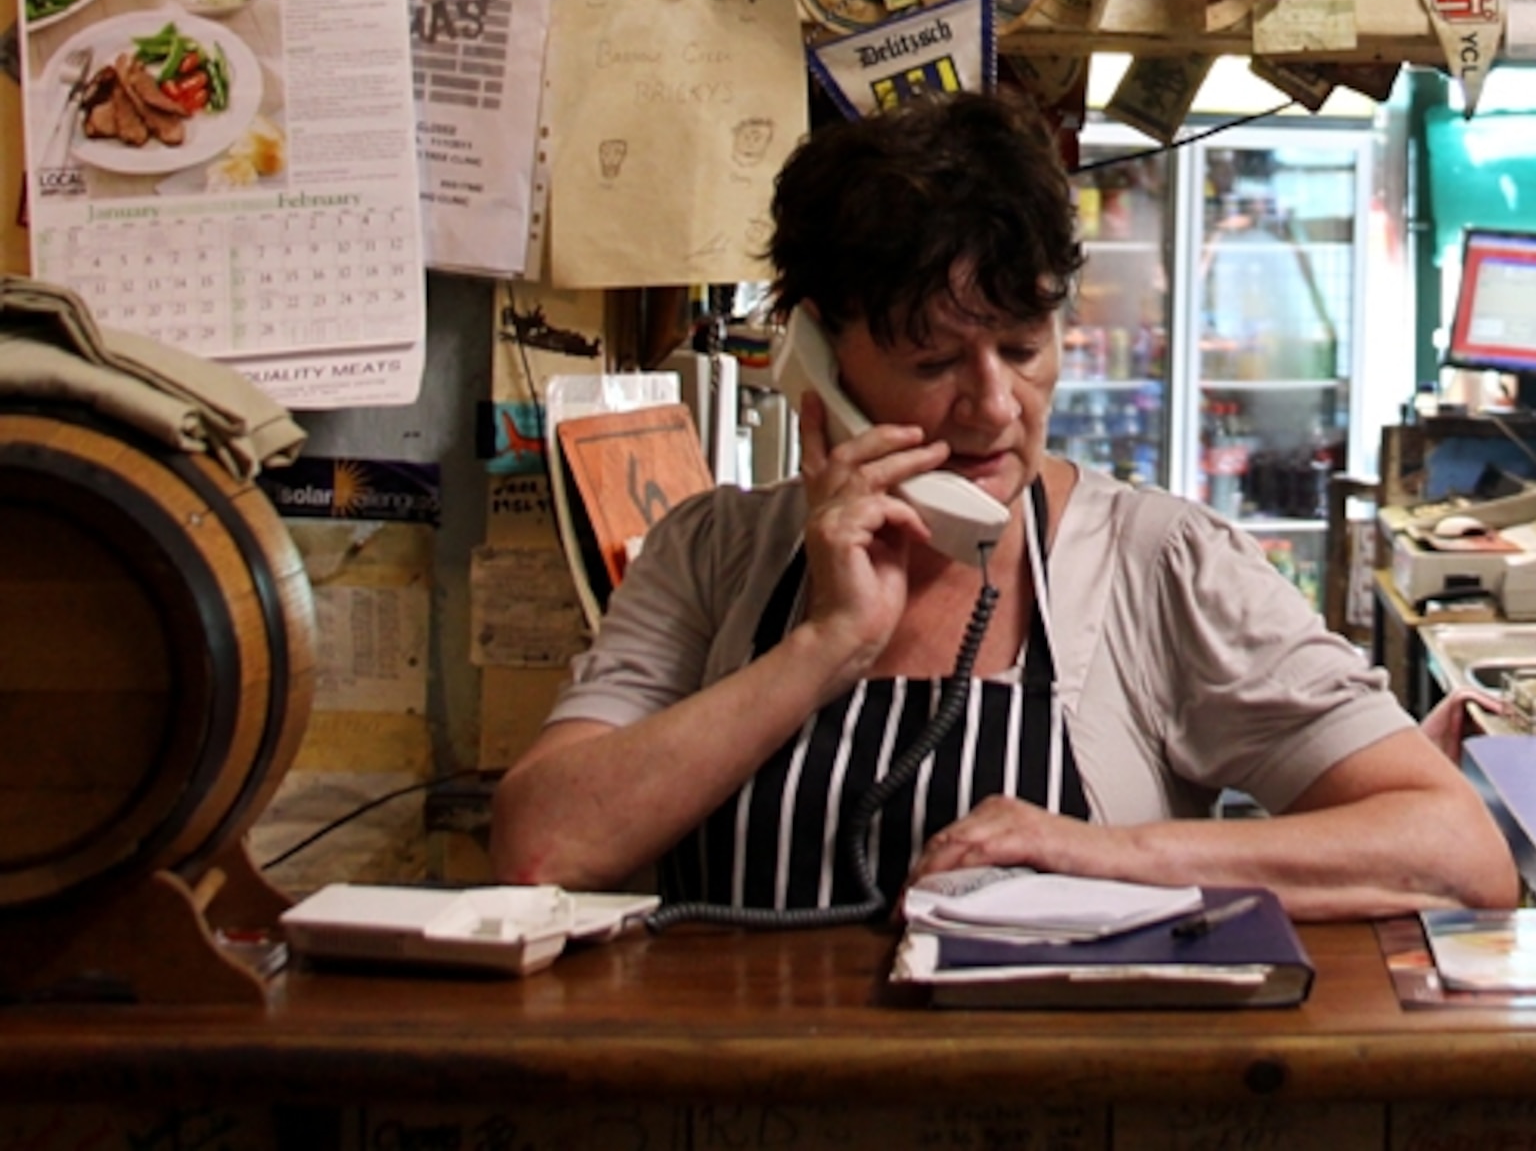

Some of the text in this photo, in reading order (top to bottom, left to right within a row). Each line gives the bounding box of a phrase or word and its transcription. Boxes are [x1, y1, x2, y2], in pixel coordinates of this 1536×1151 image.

[1460, 31, 1479, 78] YCL
[39, 174, 84, 187] LOCAL
[278, 191, 362, 210] February
[87, 205, 161, 222] January
[331, 359, 401, 377] MEATS
